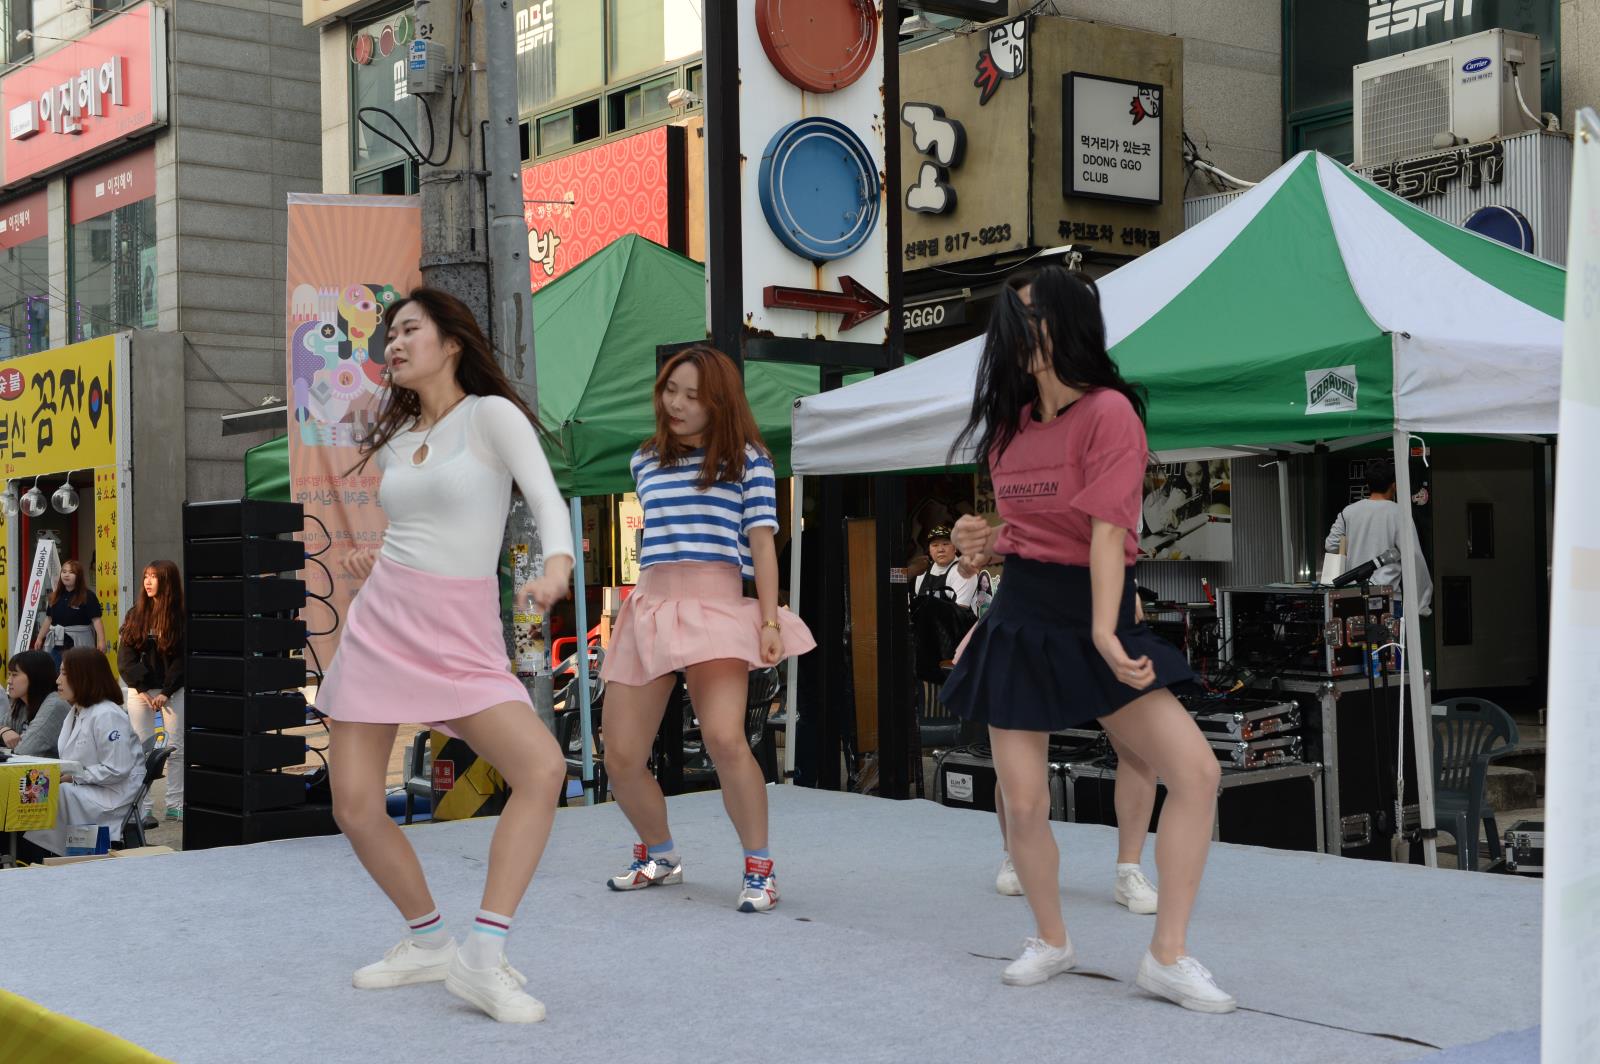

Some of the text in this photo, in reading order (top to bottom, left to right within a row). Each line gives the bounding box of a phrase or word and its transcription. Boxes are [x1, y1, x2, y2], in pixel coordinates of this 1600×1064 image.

[516, 0, 553, 33] MBC
[516, 23, 553, 54] ESPN
[1464, 59, 1489, 72] Carrier
[40, 55, 122, 134] 이진헤어
[1081, 135, 1151, 156] 먹거리가 있는곳
[1082, 153, 1142, 171] DDONG GGO
[1082, 170, 1109, 183] CLUB
[107, 170, 133, 195] 이진헤어
[944, 223, 1011, 252] 817-9233
[1058, 220, 1160, 249] 퓨전포차 선학점
[1310, 374, 1355, 404] CARAVAN
[31, 359, 114, 454] 꼼장어
